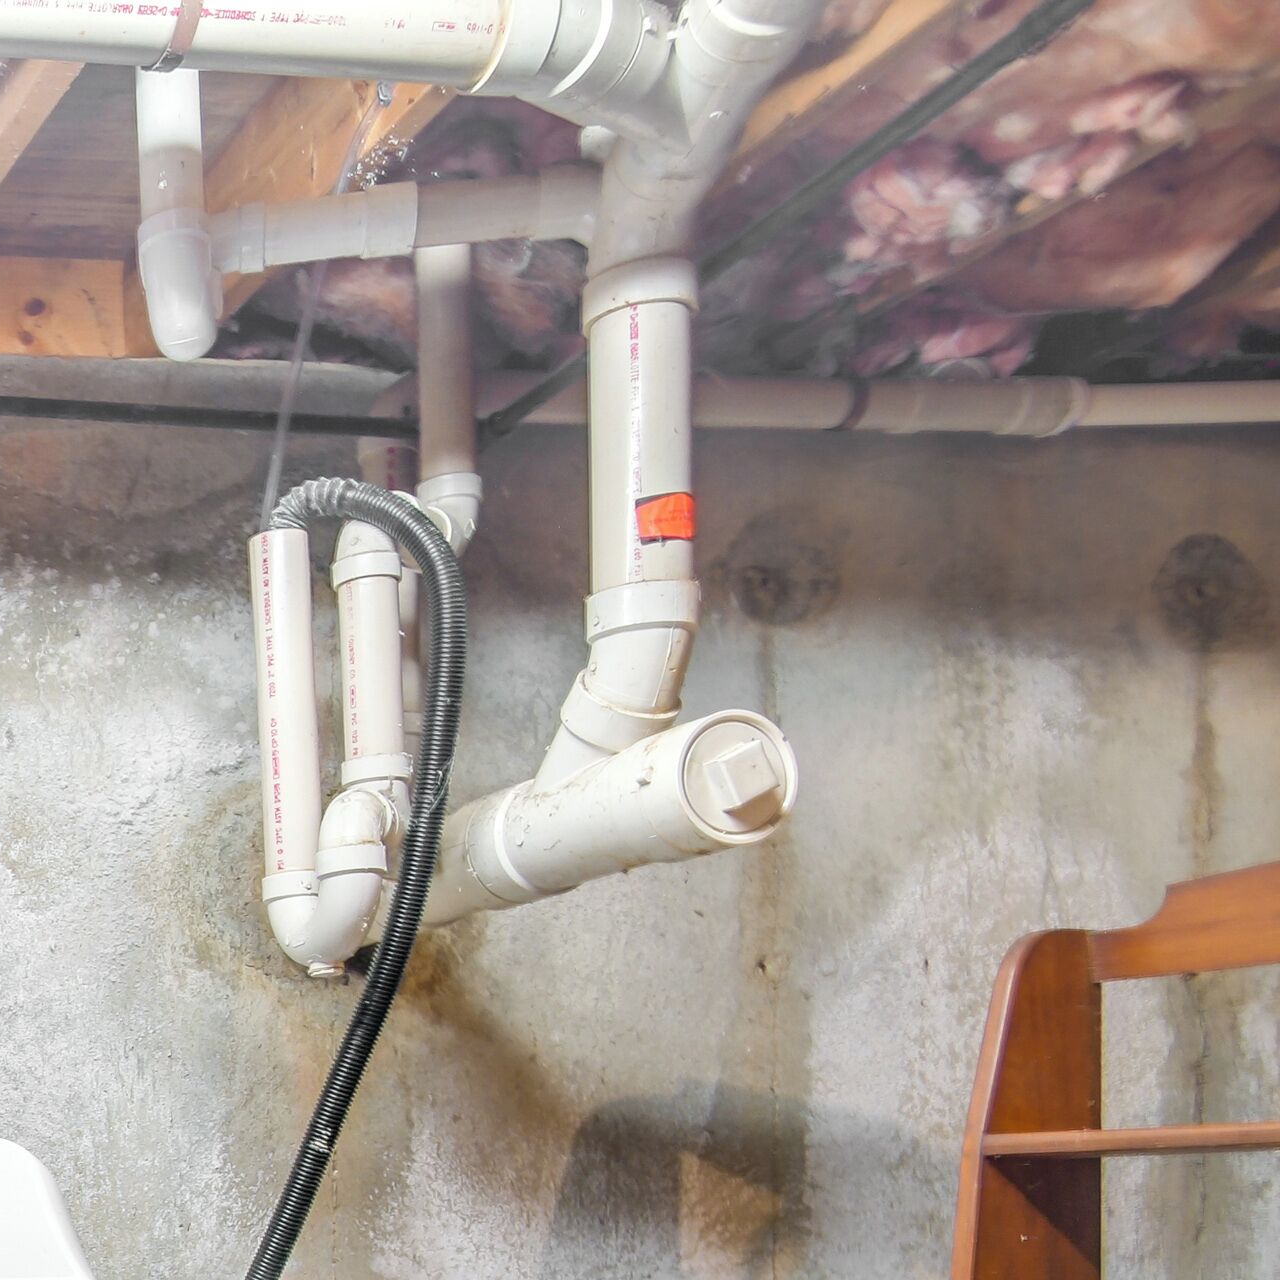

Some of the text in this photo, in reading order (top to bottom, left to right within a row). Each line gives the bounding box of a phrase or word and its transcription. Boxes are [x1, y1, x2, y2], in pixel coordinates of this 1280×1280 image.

[261, 557, 269, 575] ASTM
[262, 579, 270, 588] 40
[263, 591, 272, 625] SCHEDULE
[265, 634, 273, 651] TYPE
[266, 653, 274, 667] PVC
[274, 806, 282, 824] ASTM
